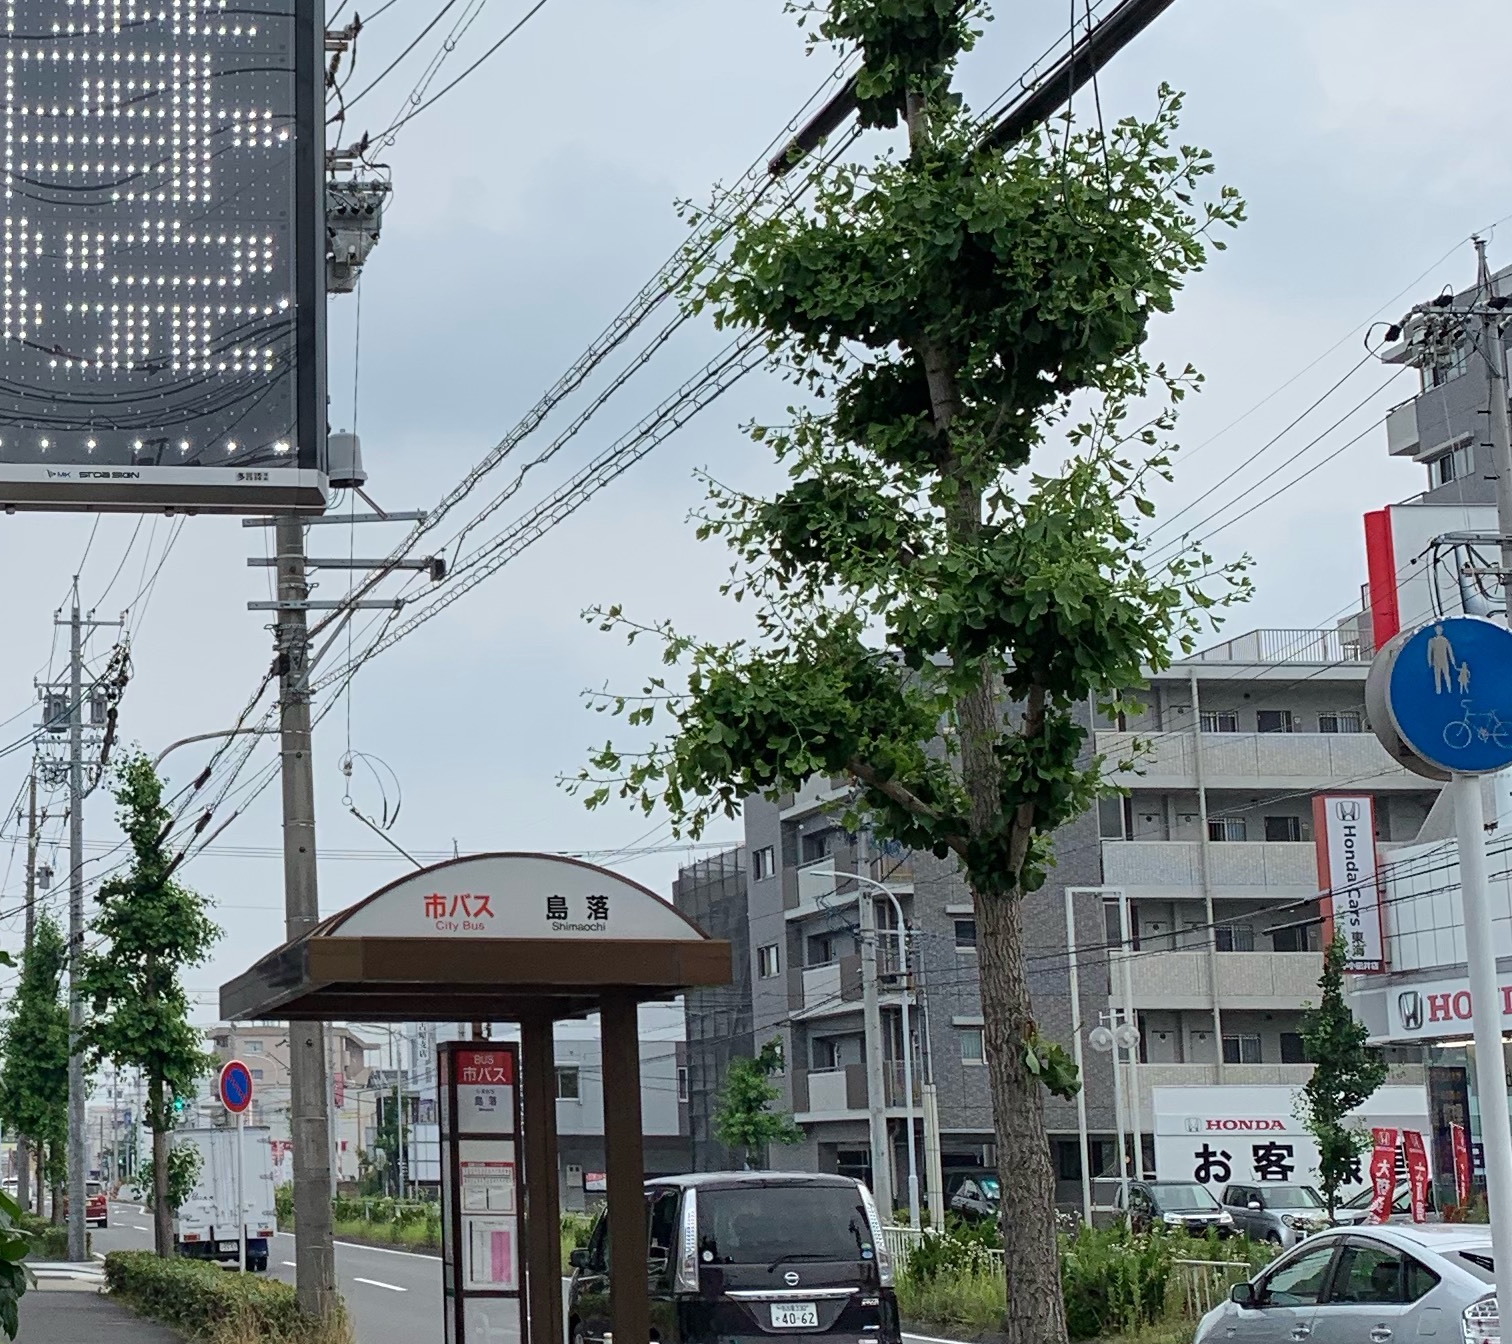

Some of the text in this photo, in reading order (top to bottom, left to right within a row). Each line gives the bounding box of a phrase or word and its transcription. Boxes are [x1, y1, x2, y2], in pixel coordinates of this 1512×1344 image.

[1343, 825, 1362, 927] Honda Cars
[423, 893, 495, 919] 市バス
[436, 921, 607, 932] City Bus Shimaochi
[473, 1054, 494, 1065] BUS
[462, 1066, 507, 1082] 市バス
[1205, 1119, 1287, 1131] HONDA
